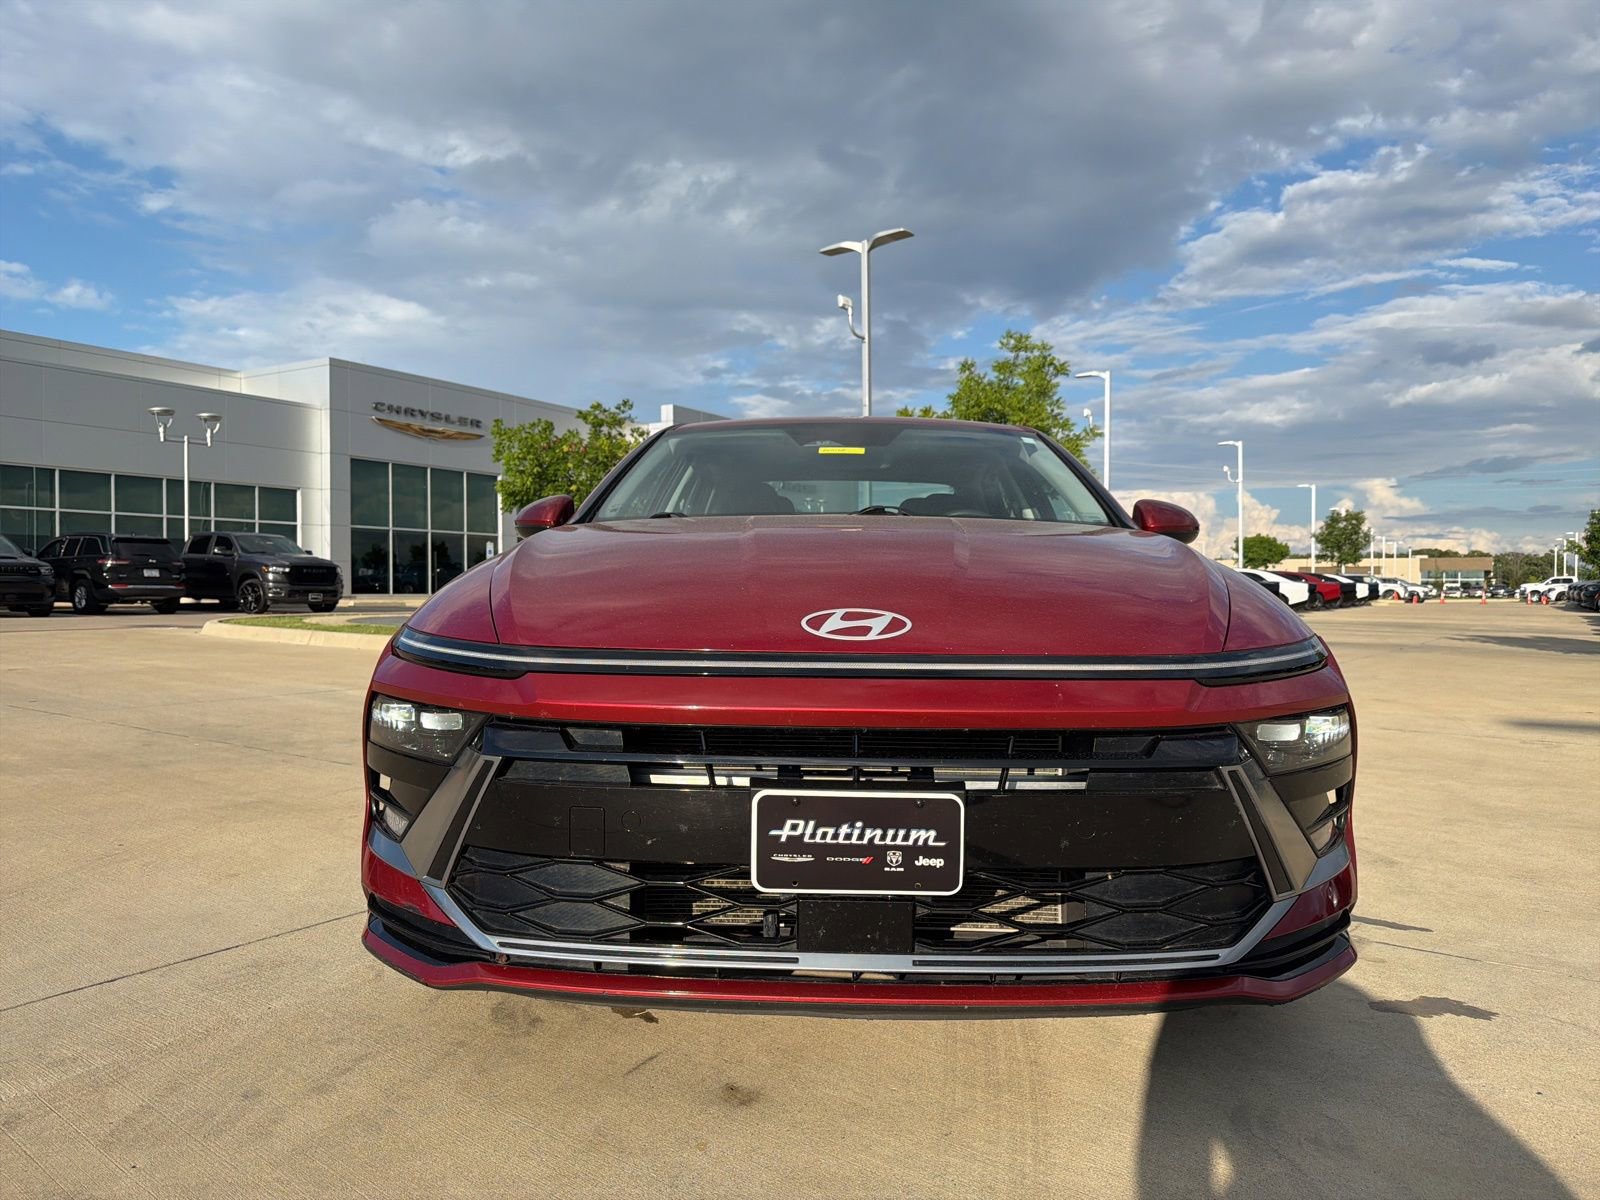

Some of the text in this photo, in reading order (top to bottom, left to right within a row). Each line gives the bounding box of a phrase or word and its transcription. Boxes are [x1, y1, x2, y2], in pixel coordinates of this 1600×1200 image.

[373, 402, 482, 428] CHRYSLER
[768, 819, 949, 846] Platinum
[914, 855, 945, 868] Jeep
